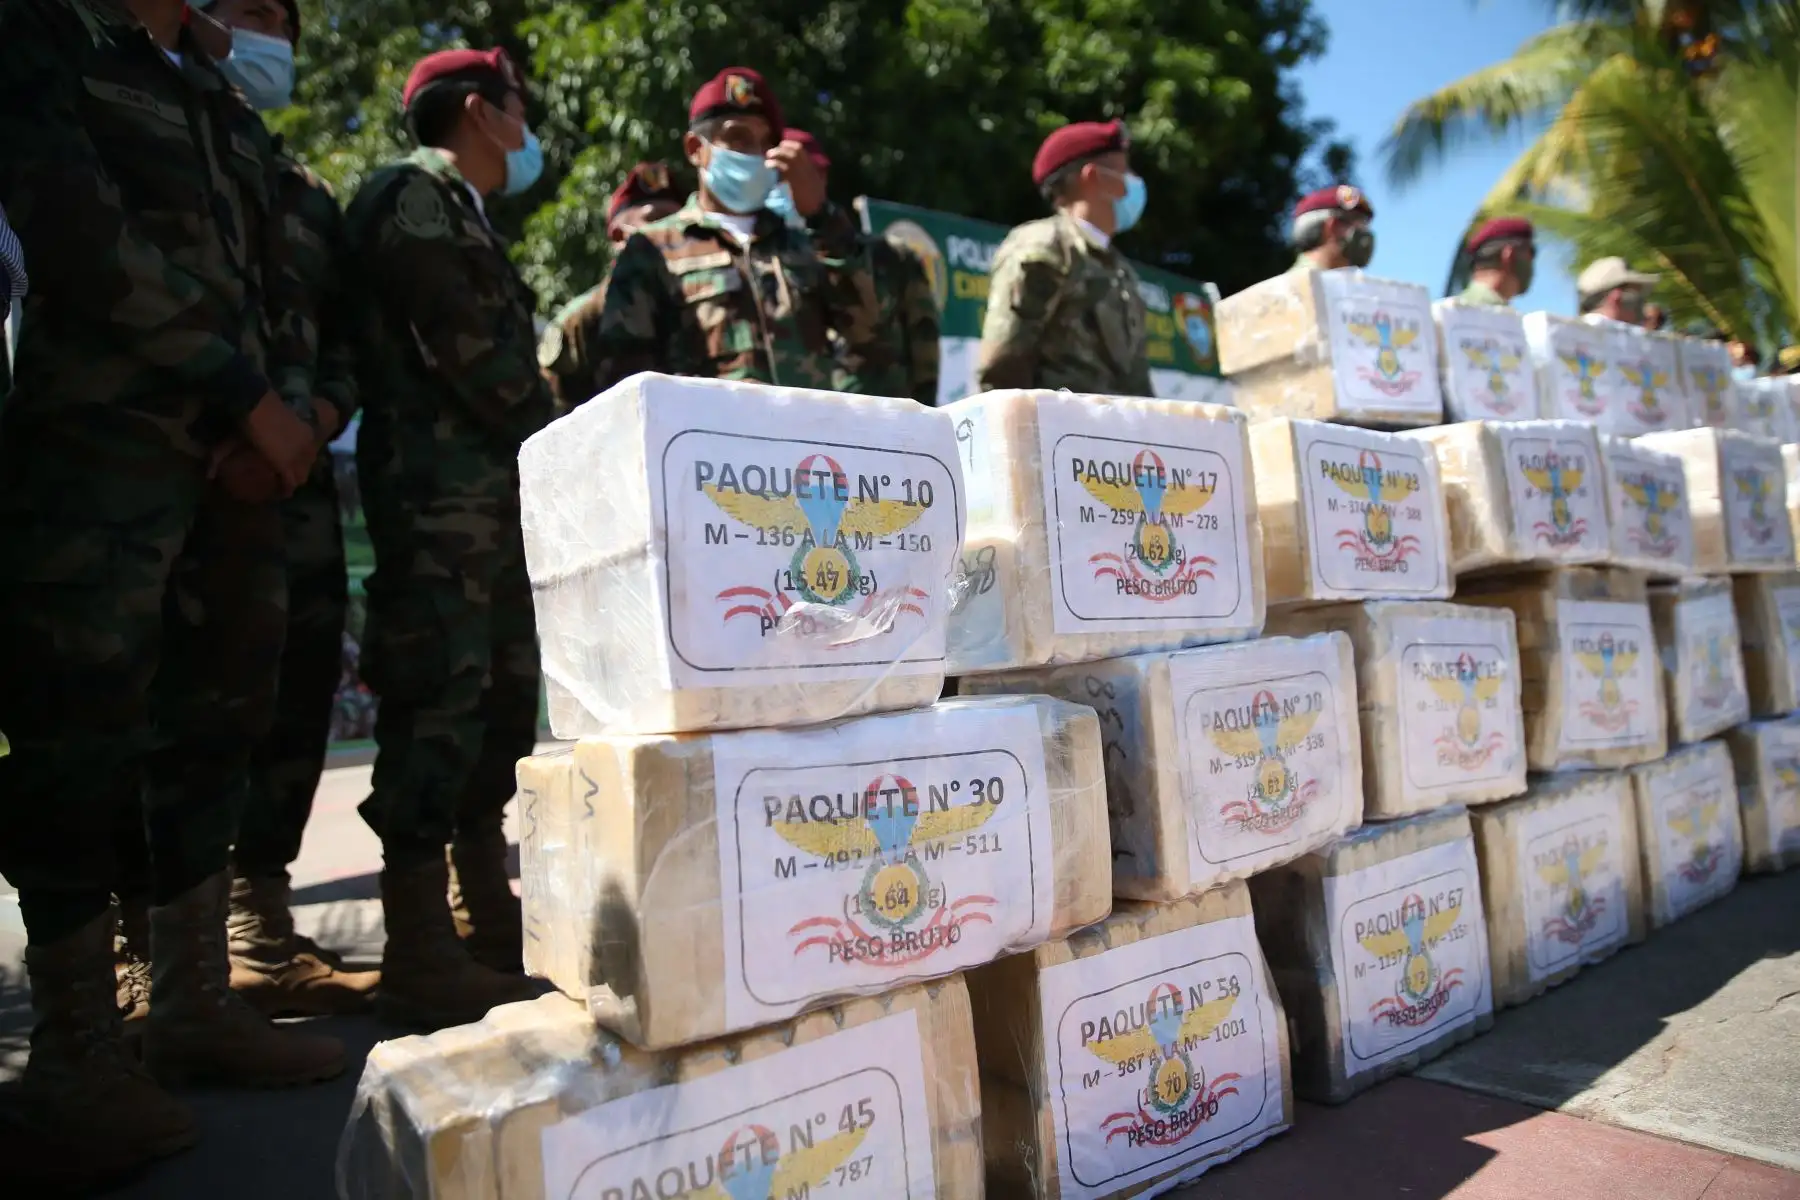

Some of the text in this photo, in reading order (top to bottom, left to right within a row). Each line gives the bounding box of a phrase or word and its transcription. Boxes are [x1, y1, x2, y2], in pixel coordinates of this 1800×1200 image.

[946, 233, 1000, 272] POLI
[695, 460, 934, 508] PAQUETE N° 10
[1072, 458, 1218, 494] PAQUETE N° 17
[1320, 460, 1384, 488] PAQUETE
[1110, 508, 1135, 525] 259
[1197, 514, 1218, 530] 278
[756, 525, 795, 547] 136
[899, 533, 932, 552] 150
[1116, 578, 1198, 595] PESO BRUTO
[1202, 702, 1280, 733] PAQUETE
[763, 776, 1004, 827] PAQUETE N° 30
[965, 833, 1002, 855] 511
[1355, 888, 1464, 943] PAQUETE N° 67
[828, 924, 961, 963] PESO BRUTO
[1080, 974, 1241, 1047] PAQUETE N° 58
[1215, 1018, 1248, 1043] 1001
[1127, 1099, 1219, 1148] PESO BRUTO
[602, 1097, 876, 1200] PAQUETE N° 45
[834, 1155, 874, 1187] 787
